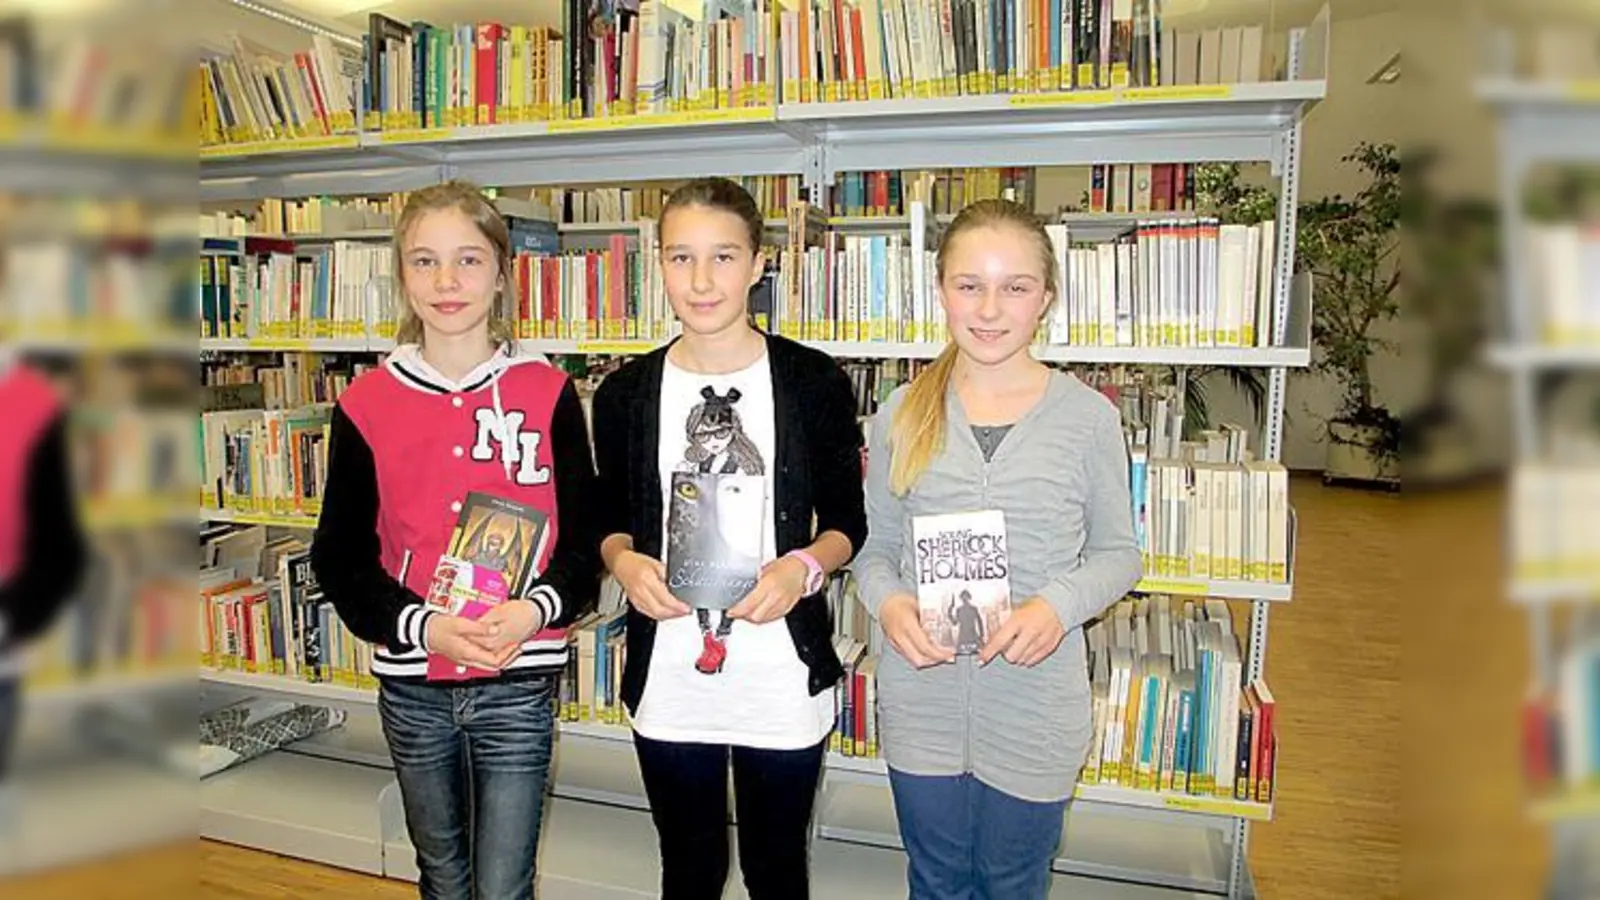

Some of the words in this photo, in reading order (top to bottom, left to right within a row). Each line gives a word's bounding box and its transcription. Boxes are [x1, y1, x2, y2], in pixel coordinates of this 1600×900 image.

[471, 407, 551, 486] ML
[917, 533, 1005, 560] SHERLOCK
[920, 555, 1007, 584] HOLMES
